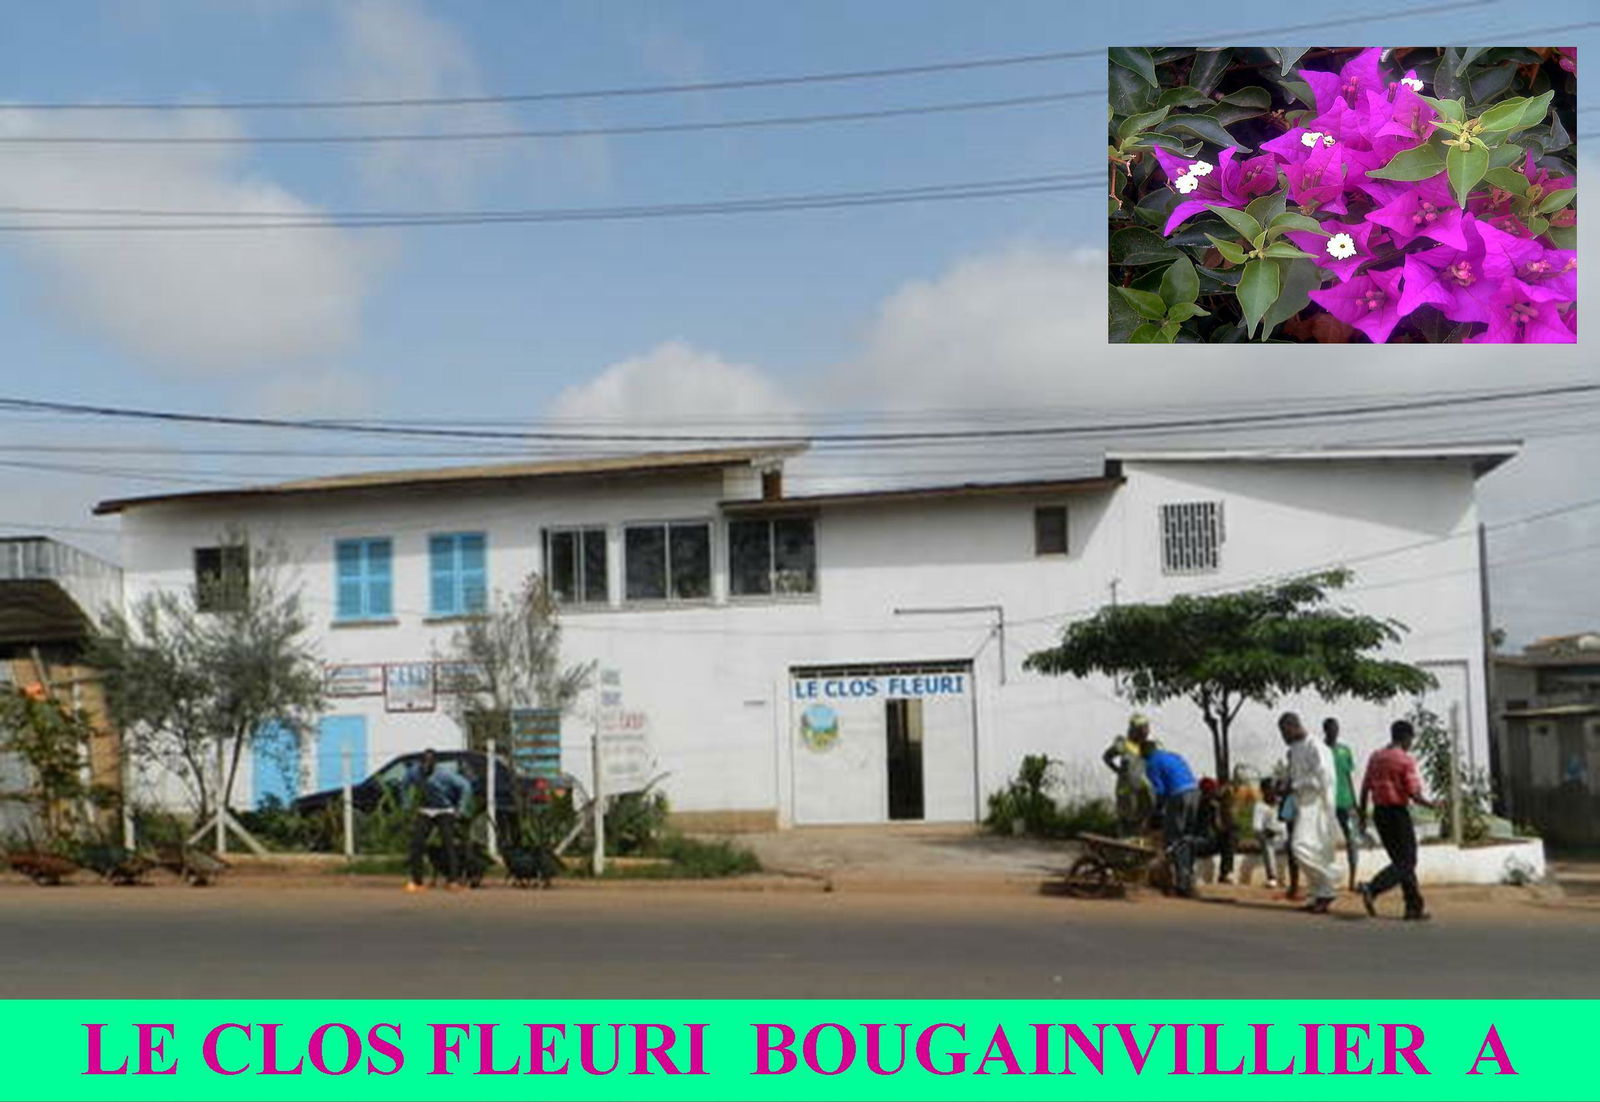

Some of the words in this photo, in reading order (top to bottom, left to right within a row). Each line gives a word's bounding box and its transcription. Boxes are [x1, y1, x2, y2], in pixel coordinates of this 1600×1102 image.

[795, 681, 818, 699] LE
[825, 679, 878, 698] CLOS
[889, 676, 964, 695] FLEURI
